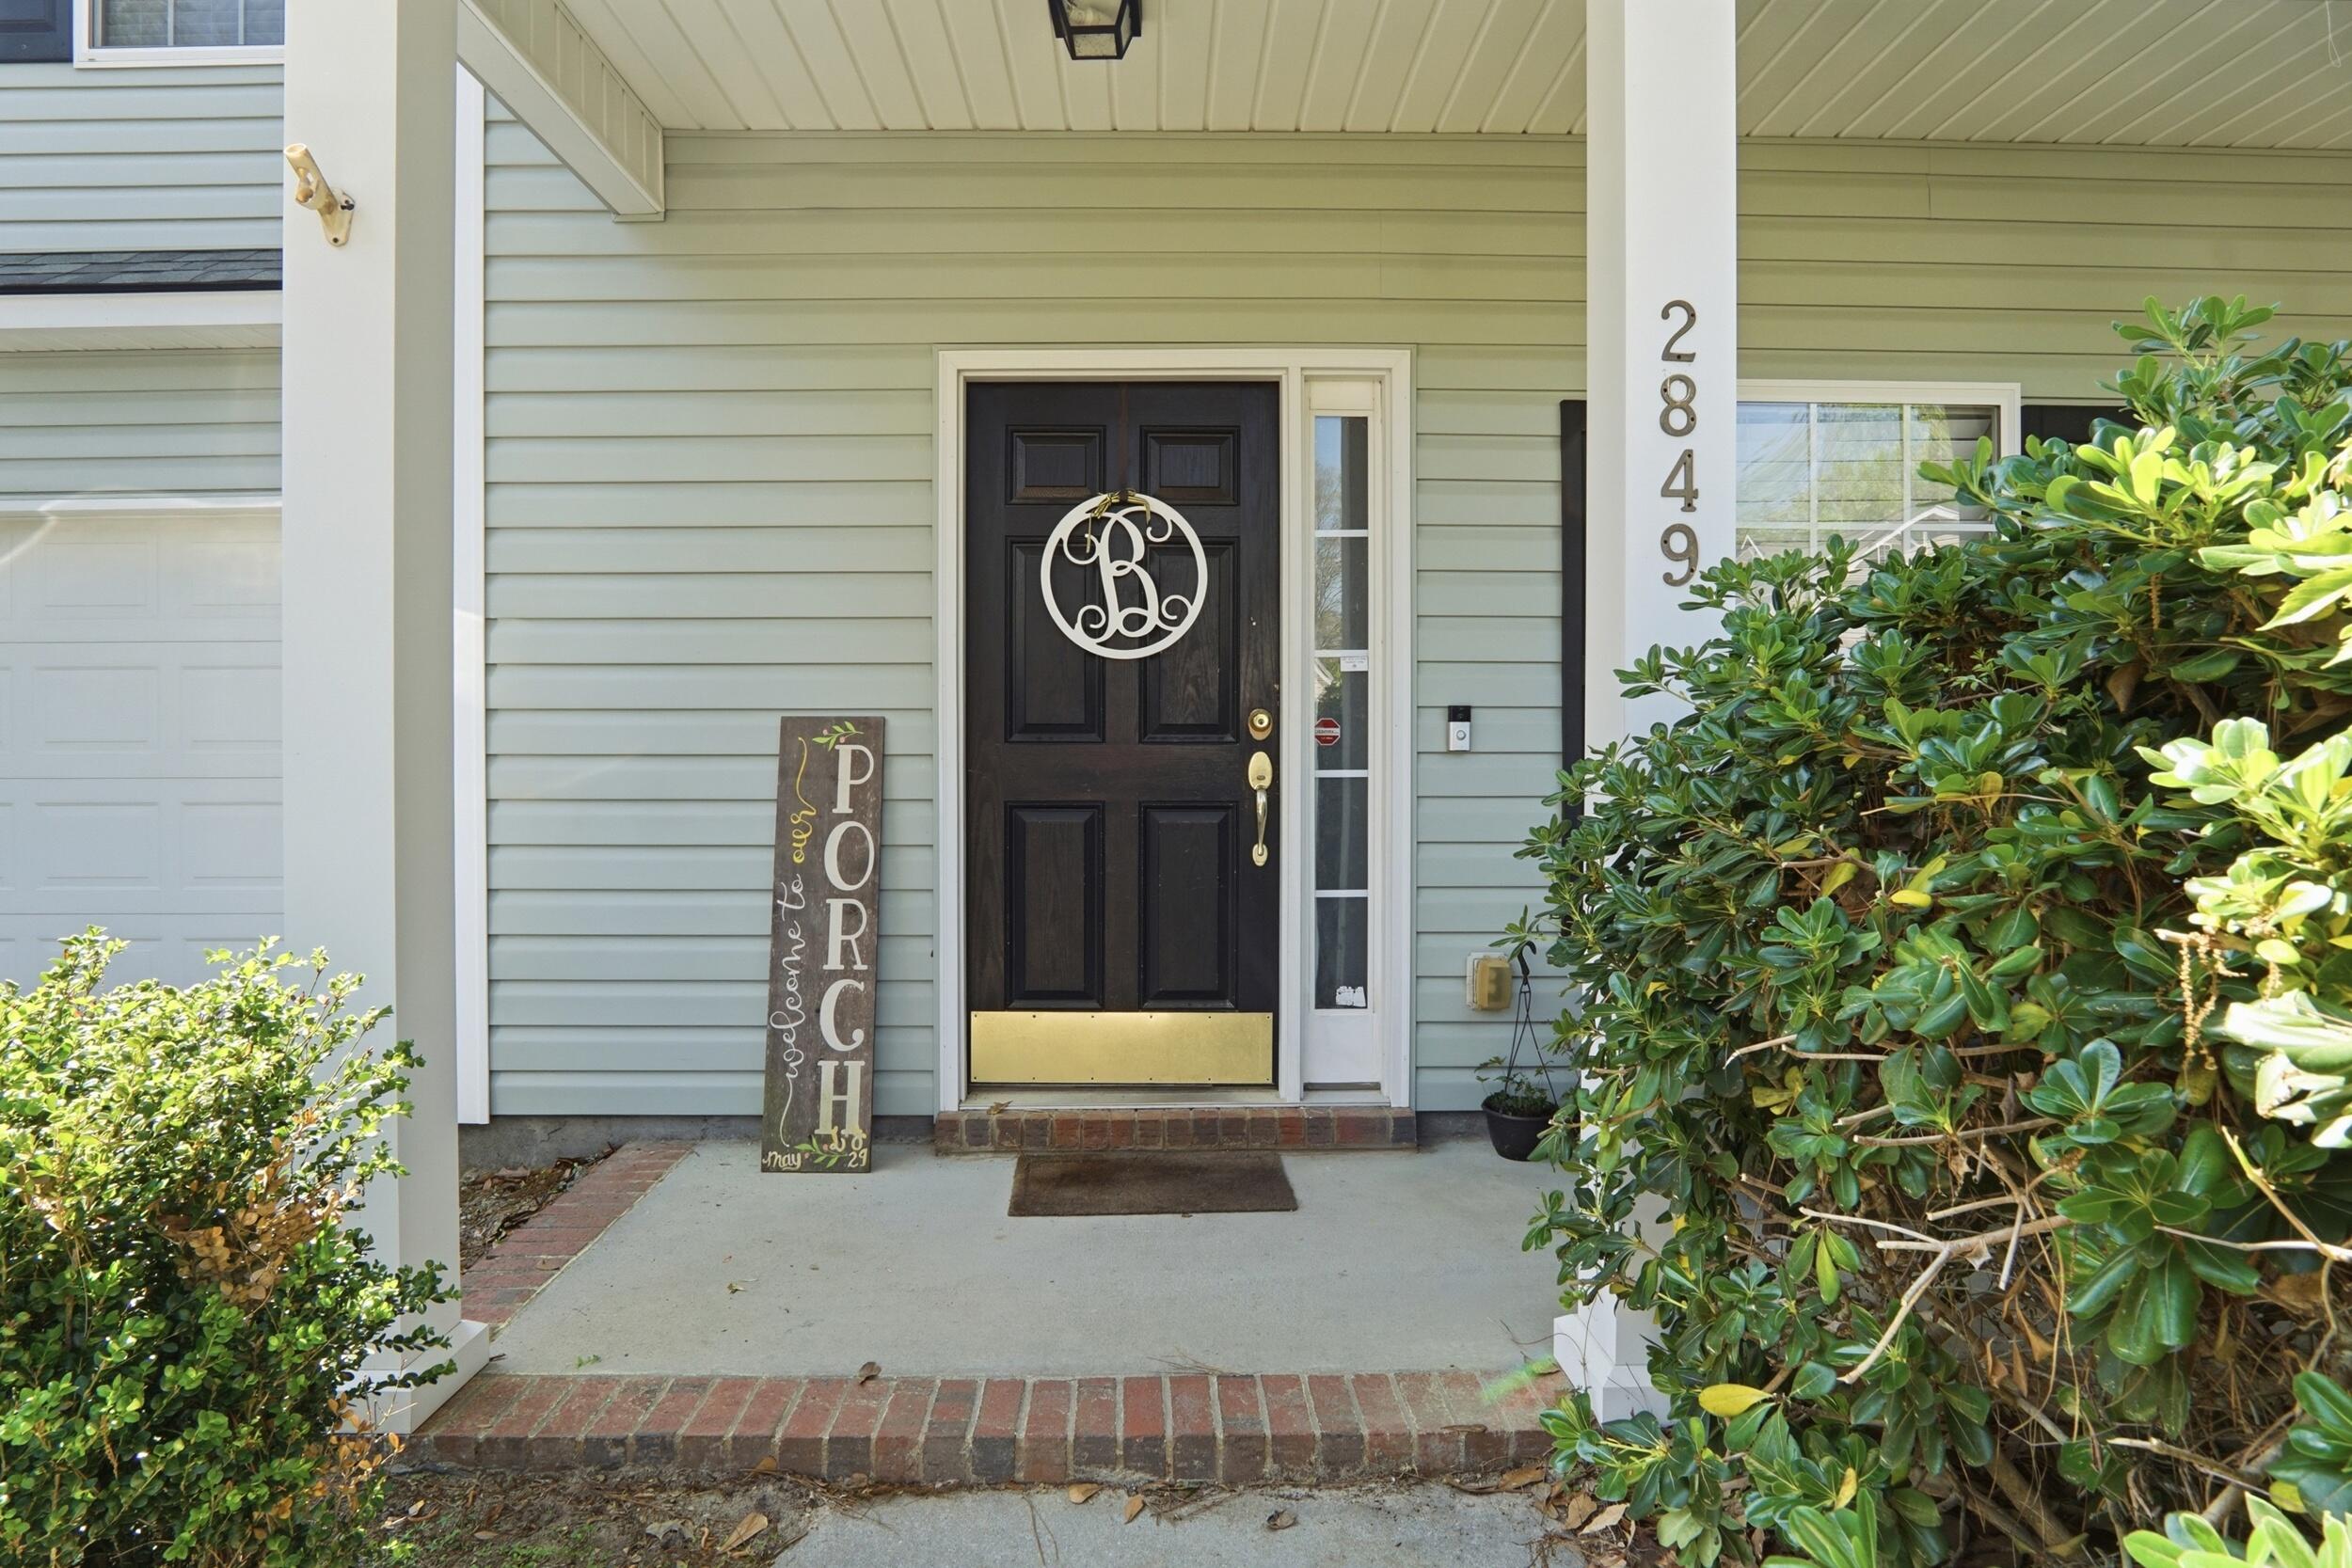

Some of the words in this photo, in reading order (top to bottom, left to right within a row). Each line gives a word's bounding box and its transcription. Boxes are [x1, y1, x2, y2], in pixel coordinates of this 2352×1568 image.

[1659, 299, 1699, 588] 2849
[1063, 505, 1194, 644] B
[790, 736, 818, 864] our
[777, 873, 806, 921] to
[814, 744, 876, 1135] PORCH
[770, 920, 806, 1148] welcome
[848, 1148, 868, 1168] 29
